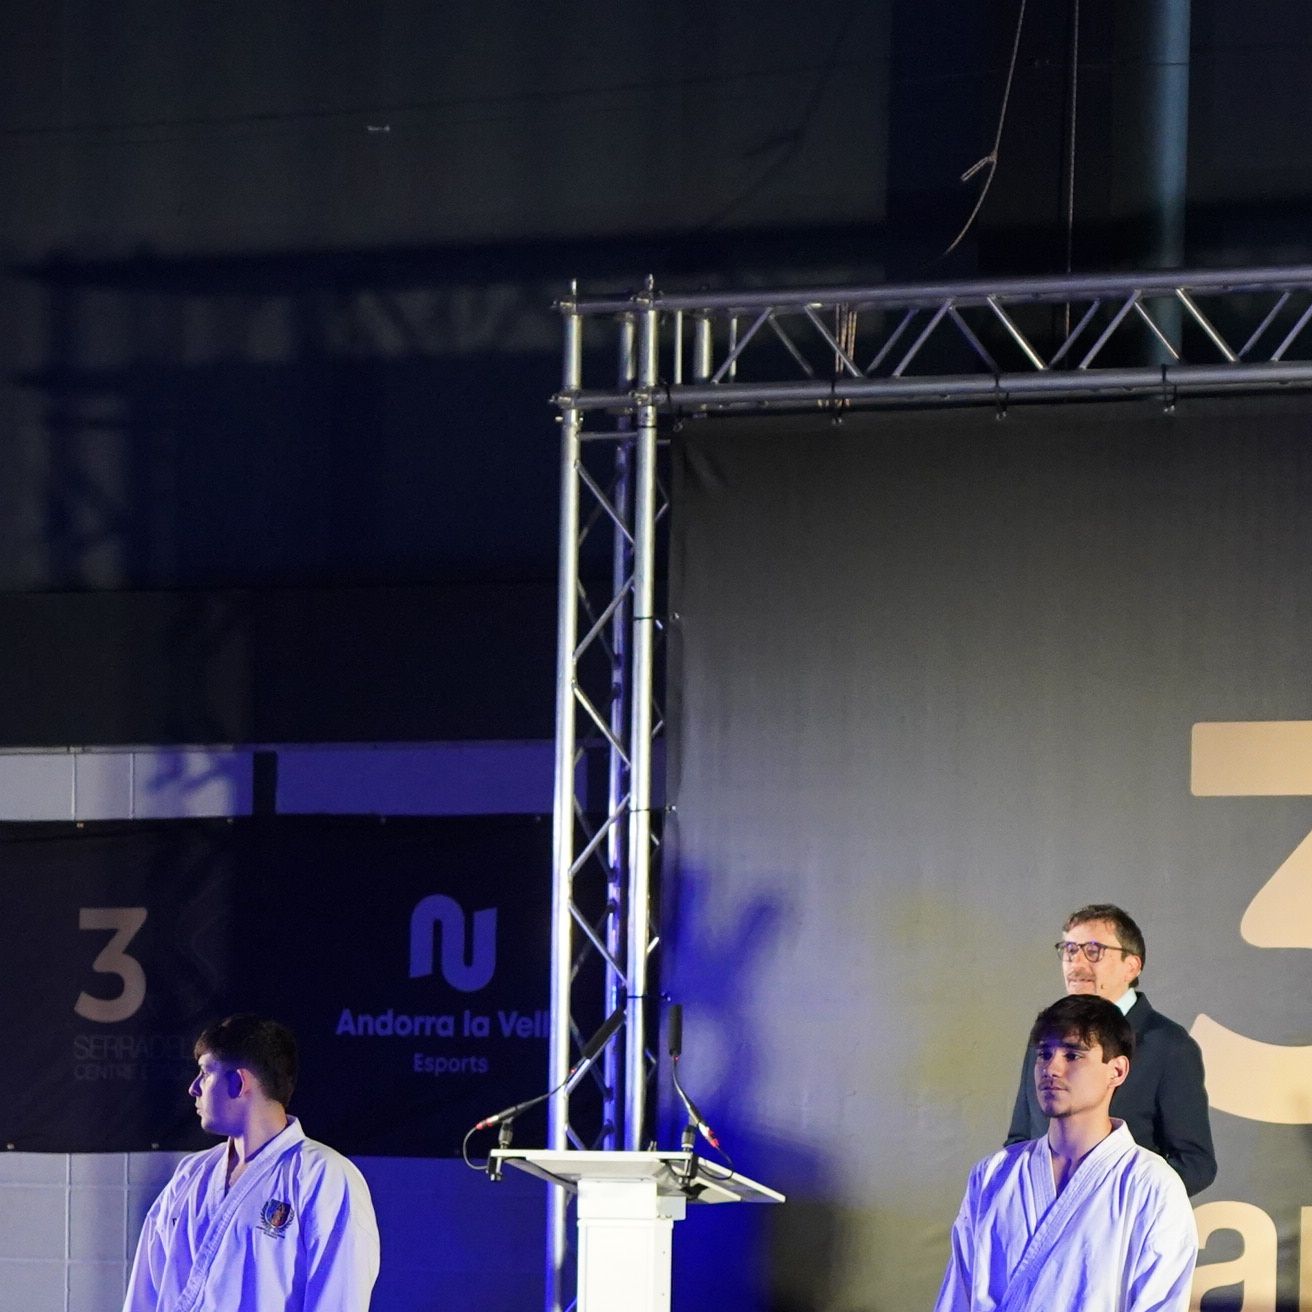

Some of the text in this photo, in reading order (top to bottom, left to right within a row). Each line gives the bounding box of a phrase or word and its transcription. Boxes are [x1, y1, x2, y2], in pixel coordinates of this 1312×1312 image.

[73, 907, 148, 1023] 3
[336, 1007, 550, 1039] Andorra la Vell
[413, 1052, 488, 1077] Esports
